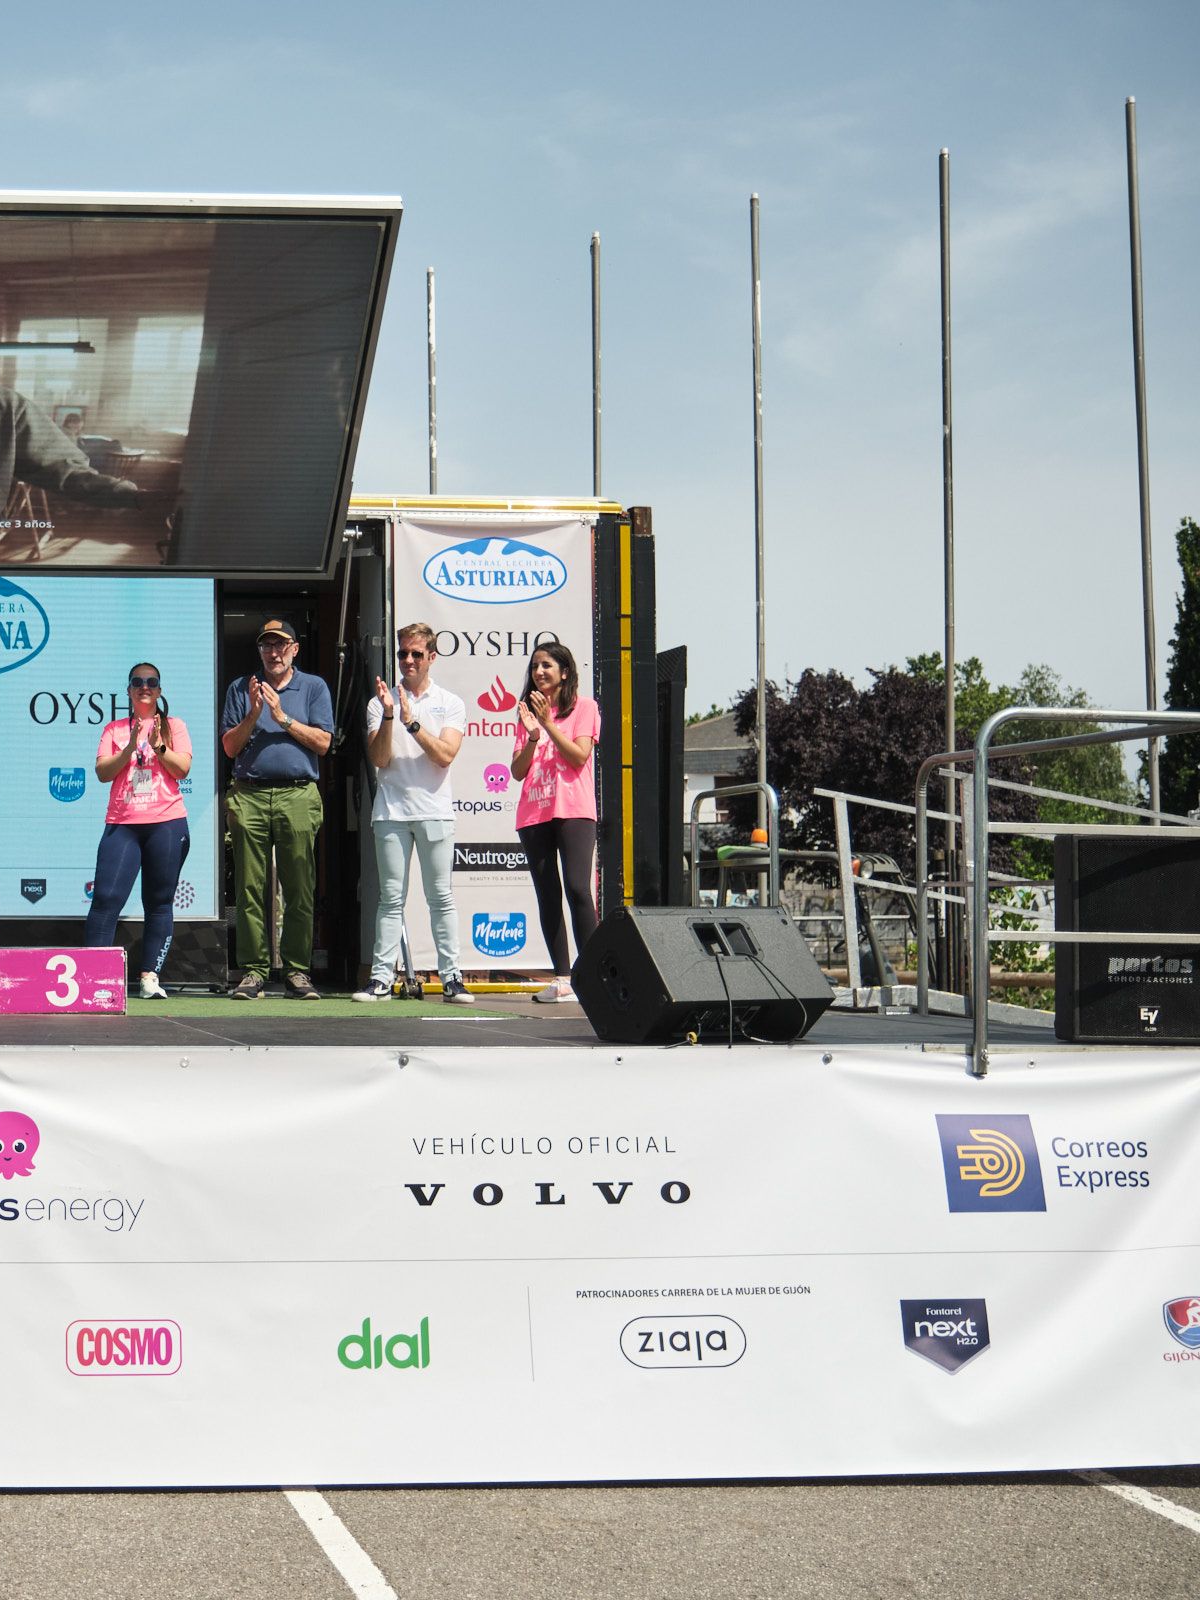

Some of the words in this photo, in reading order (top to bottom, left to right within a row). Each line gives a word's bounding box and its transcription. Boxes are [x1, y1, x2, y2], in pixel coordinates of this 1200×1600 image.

[14, 519, 21, 528] 3
[24, 519, 55, 529] años.
[434, 560, 557, 587] ASTURIANA
[1108, 956, 1193, 975] portos
[45, 955, 80, 1007] 3
[1141, 1008, 1158, 1025] EV
[412, 1133, 553, 1155] VEHÍCULO
[568, 1136, 676, 1154] OFICIAL
[1051, 1136, 1148, 1159] Correos
[1056, 1165, 1150, 1193] Express
[404, 1180, 691, 1206] VOLVO
[25, 1198, 145, 1232] energy
[576, 1289, 659, 1299] PATROCINADORES
[661, 1289, 704, 1298] CARRERA
[706, 1288, 719, 1297] DE
[721, 1288, 733, 1297] LA
[735, 1287, 766, 1296] MUJER
[768, 1287, 780, 1296] DE
[783, 1285, 811, 1296] GIJÓN
[926, 1307, 962, 1316] Fontarel
[914, 1317, 977, 1338] next
[76, 1327, 172, 1366] COSMO
[337, 1316, 430, 1370] dial
[638, 1330, 727, 1361] ziaja
